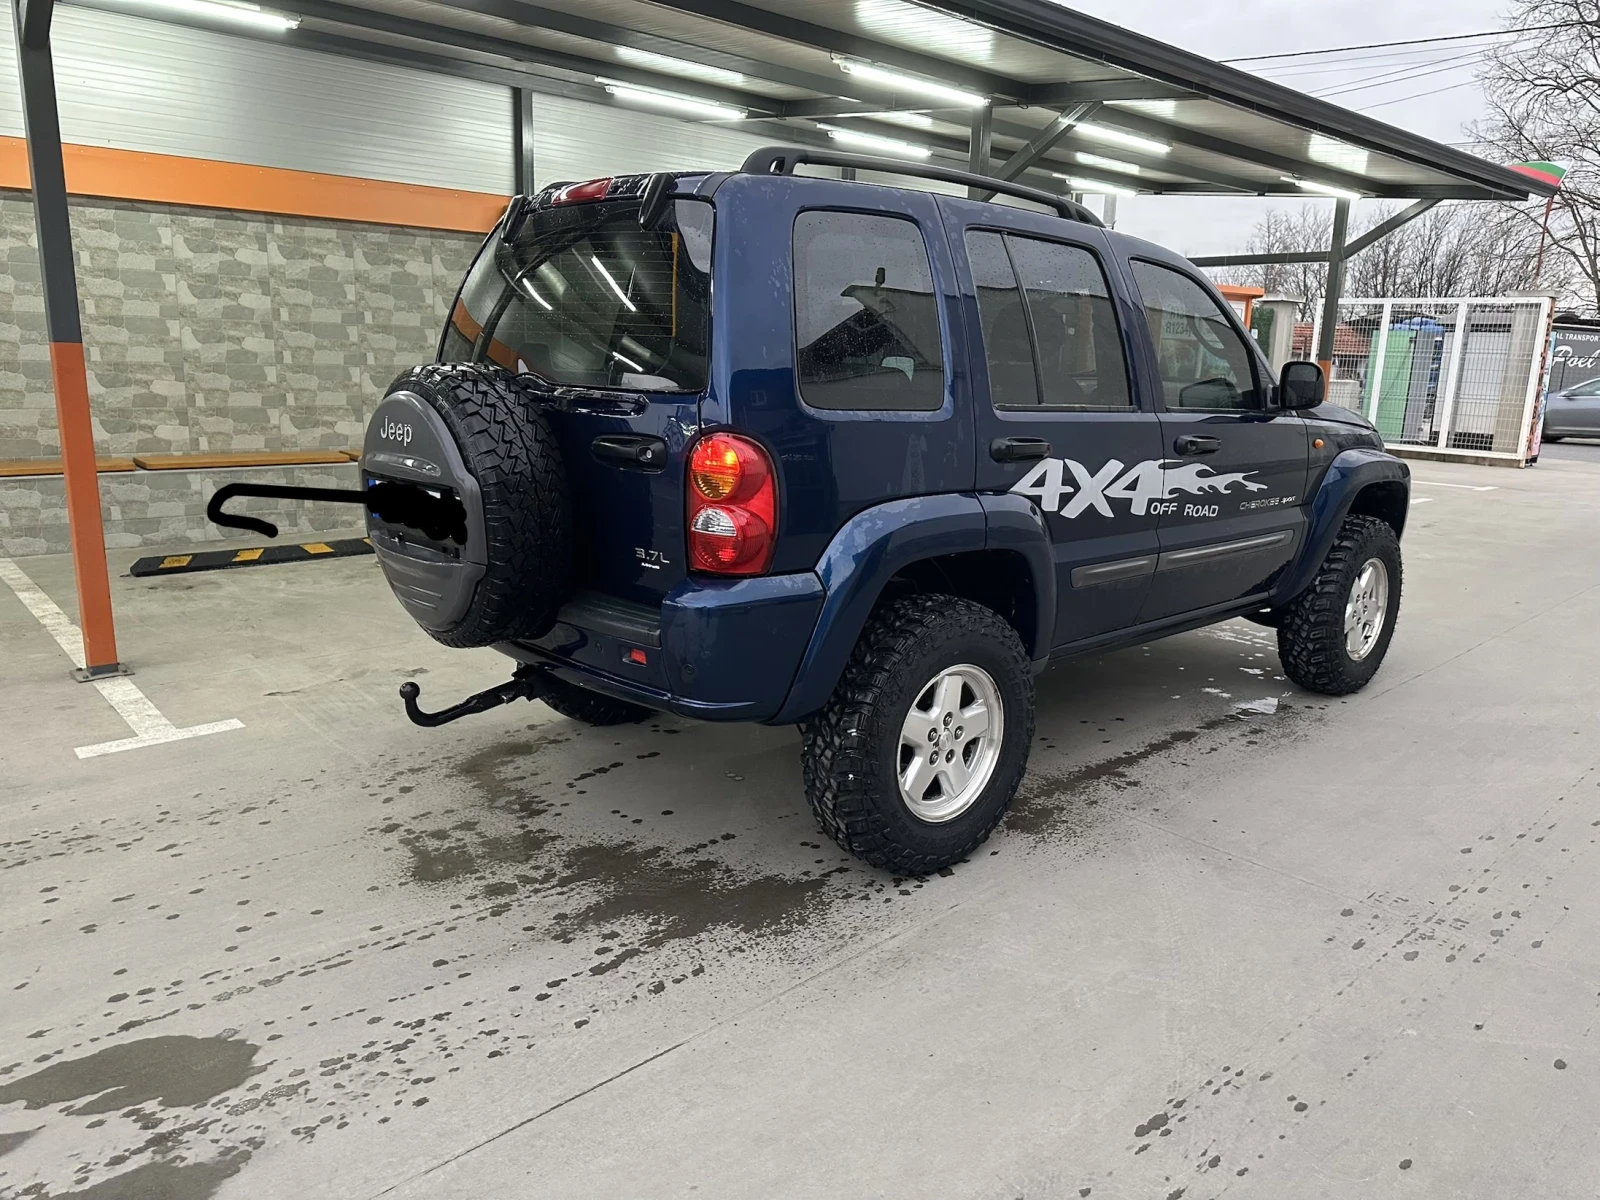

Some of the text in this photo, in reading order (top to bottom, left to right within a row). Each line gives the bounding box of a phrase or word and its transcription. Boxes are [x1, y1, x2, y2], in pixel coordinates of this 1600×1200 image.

[380, 415, 412, 447] Jeep
[1008, 458, 1166, 519] 4X4
[1150, 502, 1219, 518] OFF ROAD
[1240, 497, 1280, 510] CHEROKEE
[635, 546, 670, 564] 3.7L
